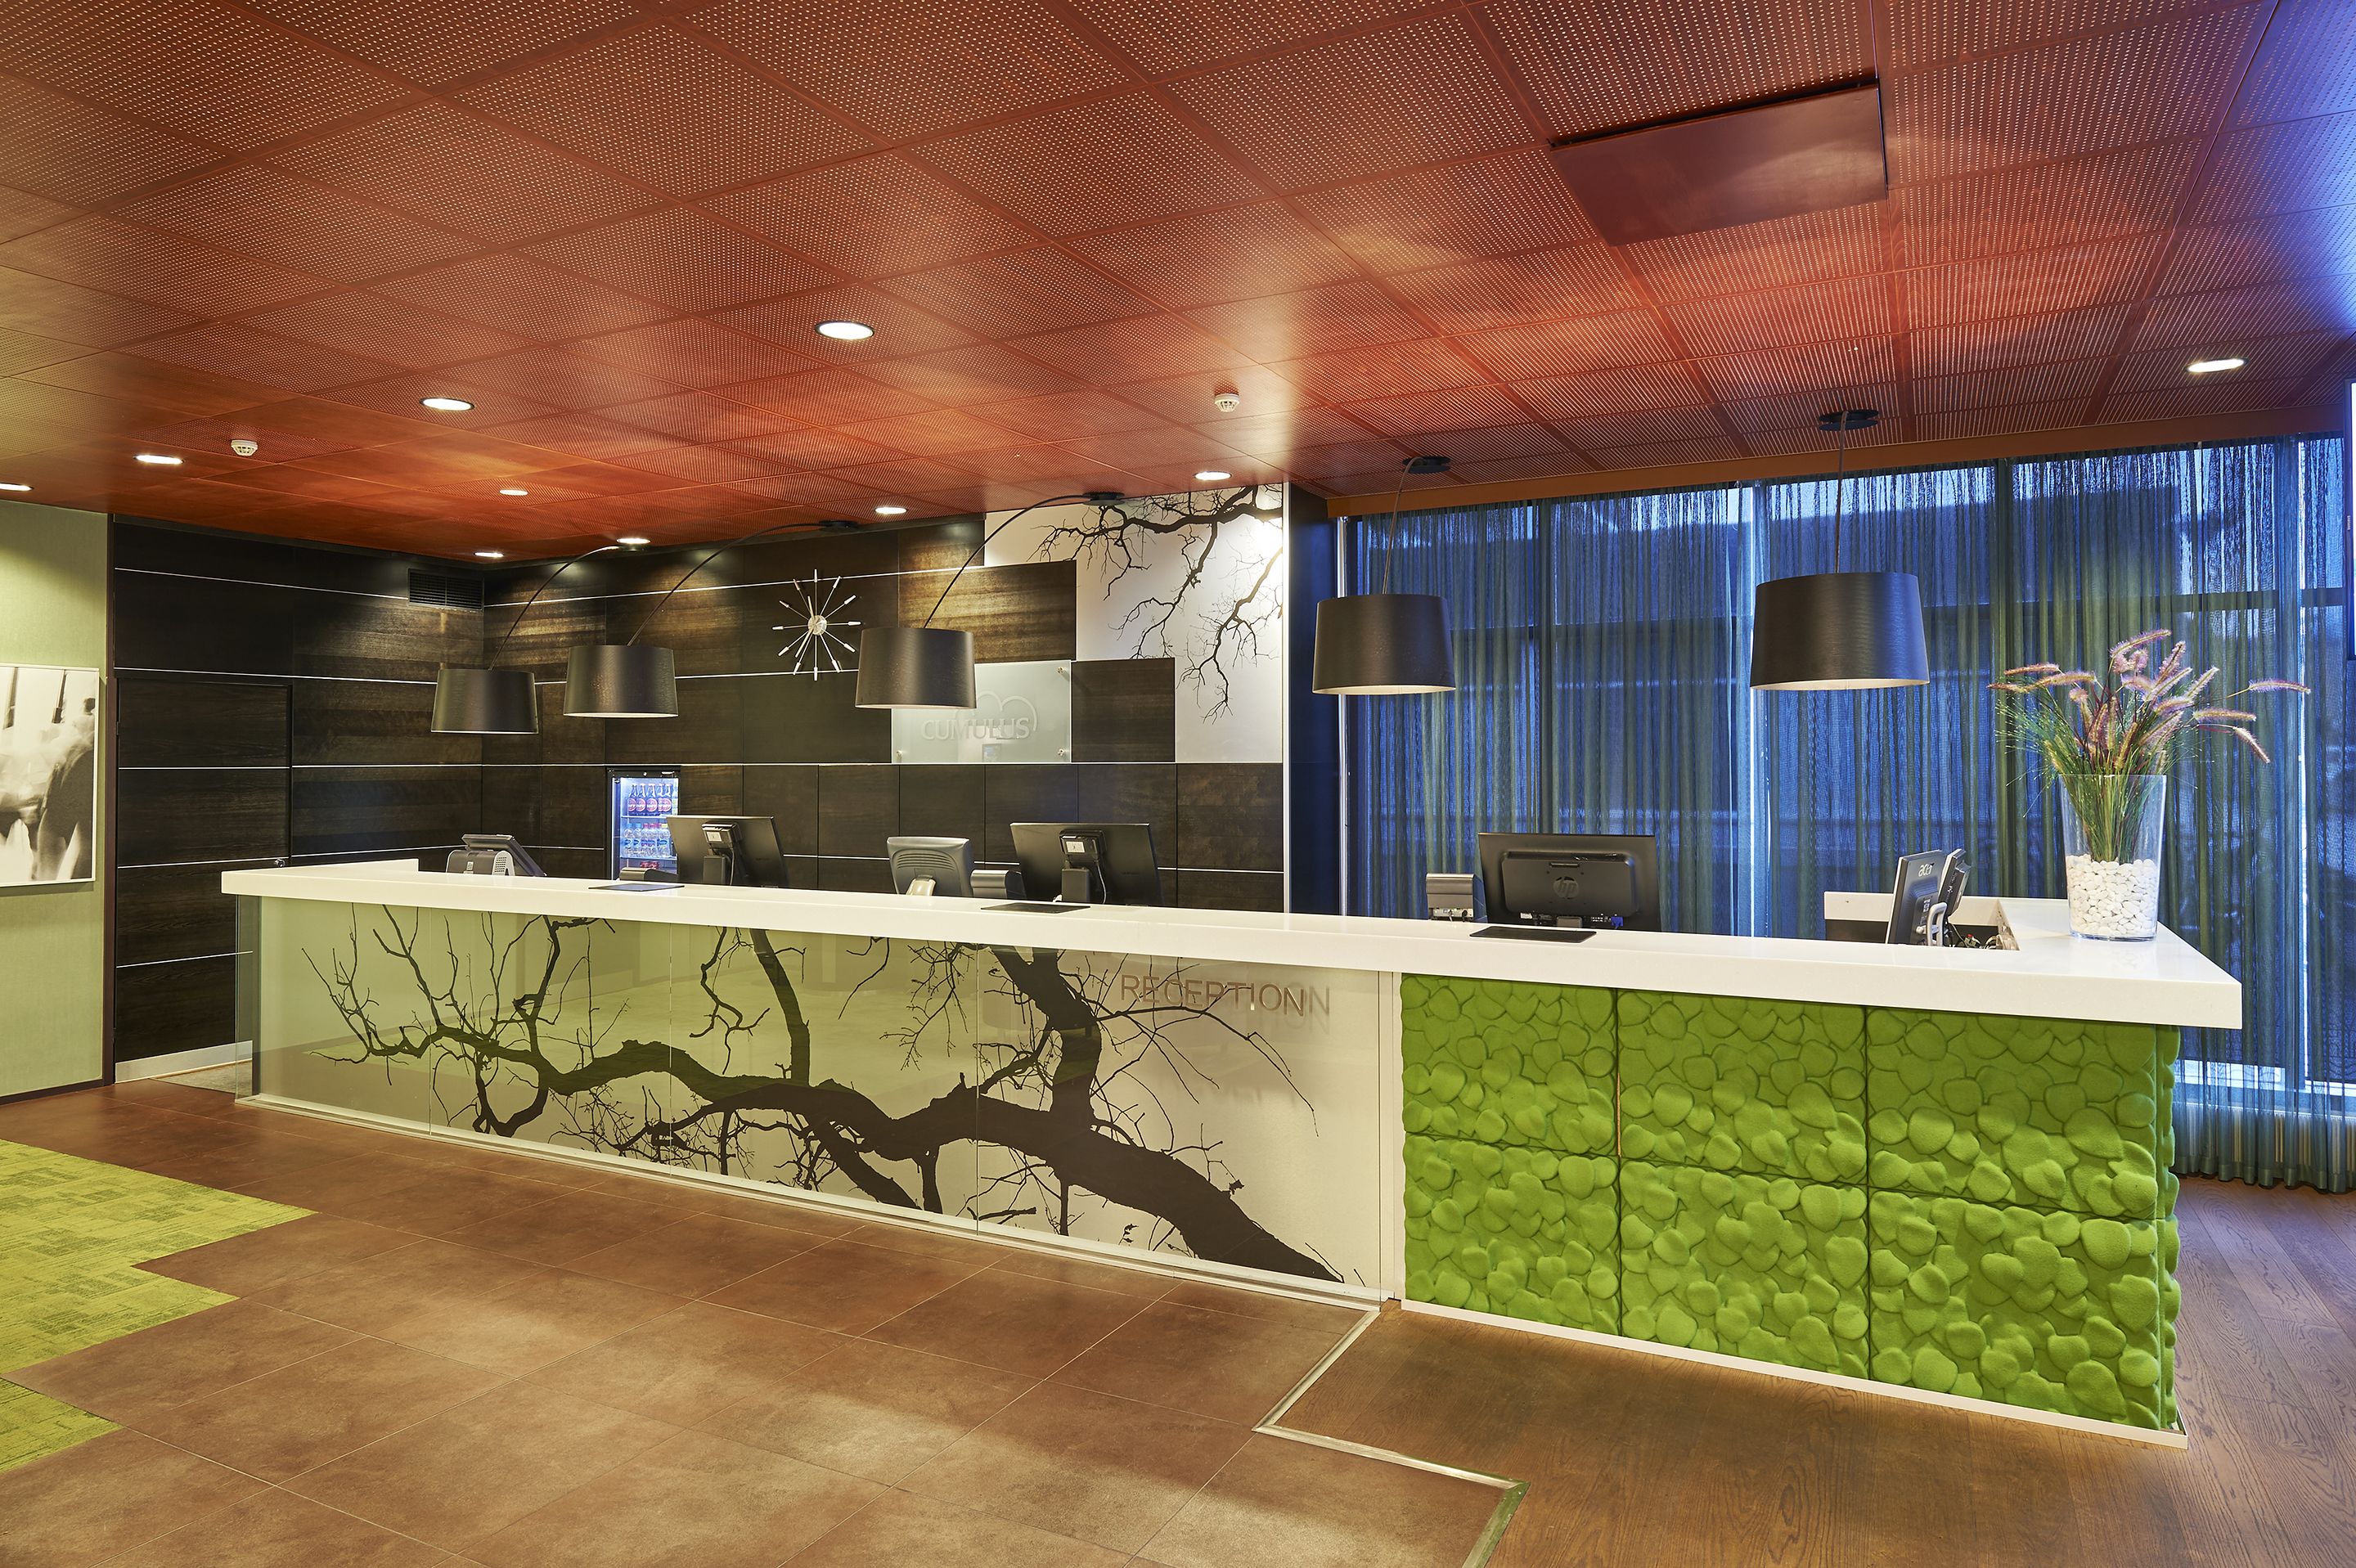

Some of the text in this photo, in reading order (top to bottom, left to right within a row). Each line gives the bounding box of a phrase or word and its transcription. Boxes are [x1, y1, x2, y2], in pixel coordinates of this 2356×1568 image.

[921, 717, 1031, 739] CUMULUS
[1918, 863, 1935, 877] acer
[1120, 974, 1304, 1017] RECEPTION
